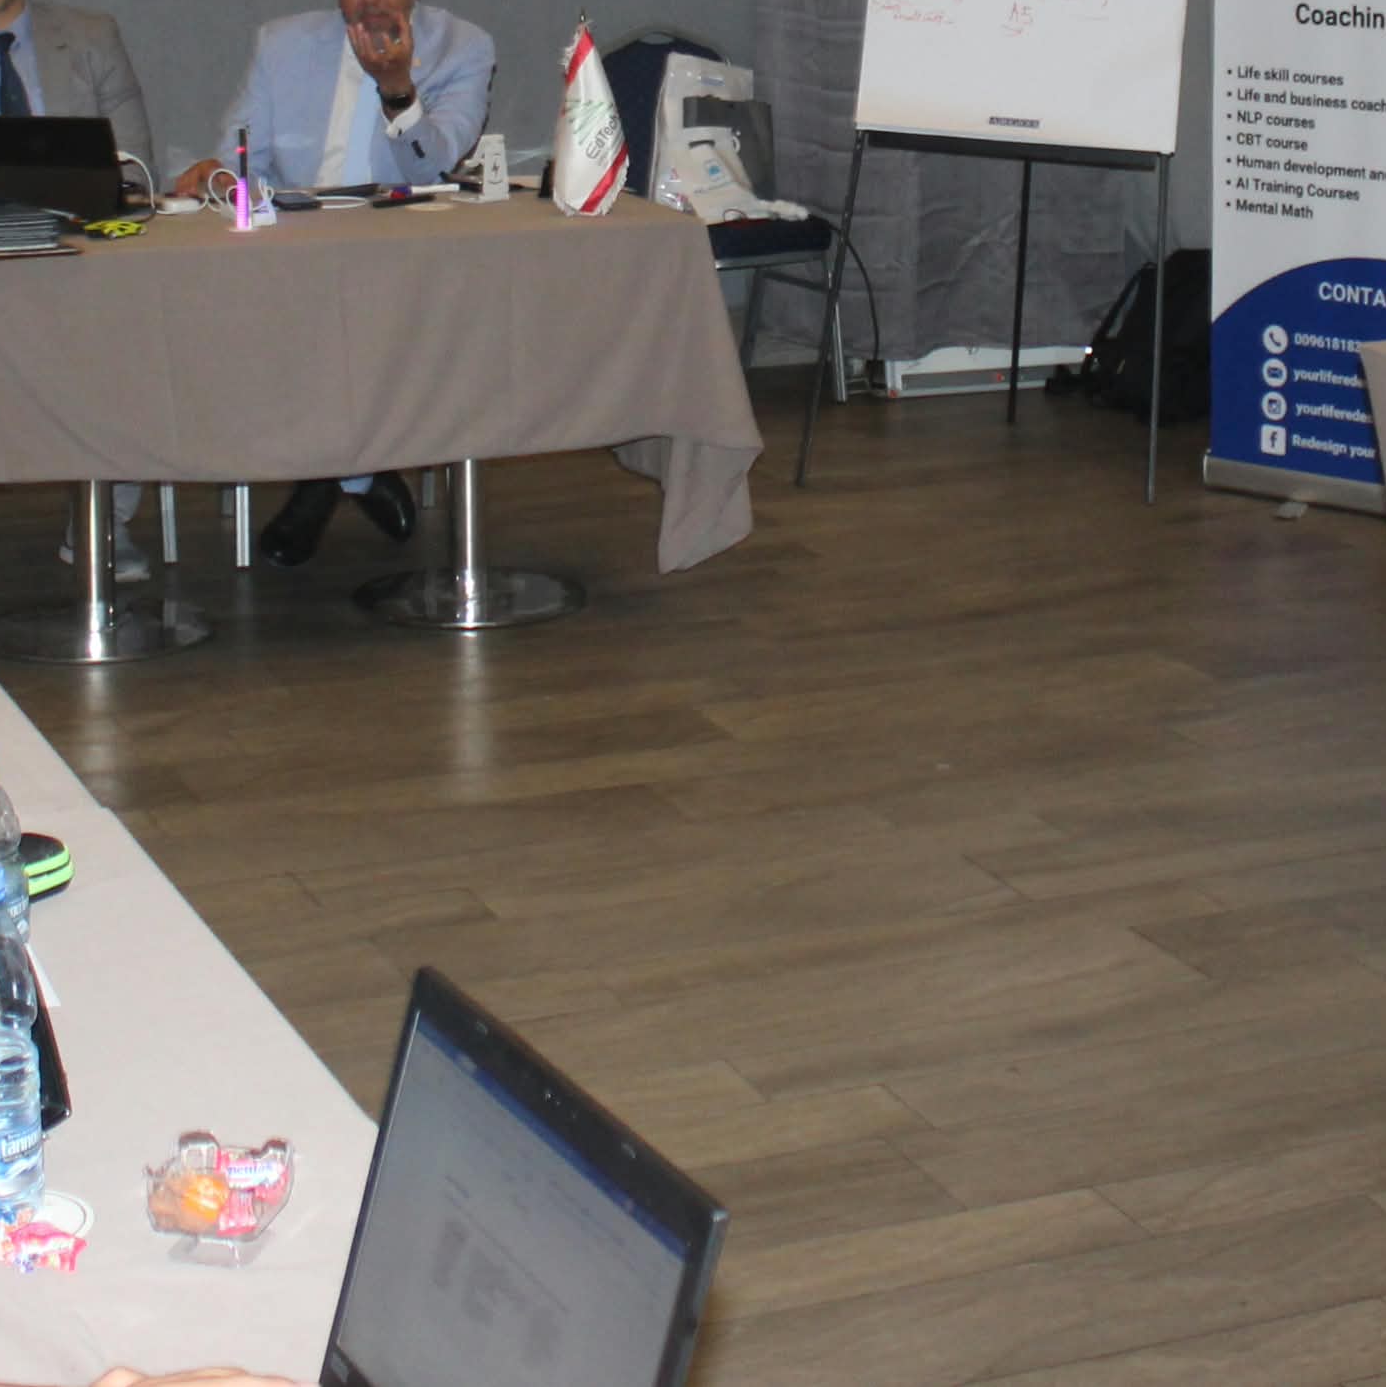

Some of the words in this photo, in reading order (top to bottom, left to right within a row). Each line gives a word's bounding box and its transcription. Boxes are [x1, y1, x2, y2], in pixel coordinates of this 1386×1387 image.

[1237, 66, 1261, 80] Life
[1264, 69, 1290, 81] skill
[1293, 72, 1344, 86] courses
[1237, 88, 1260, 102] Life
[1264, 91, 1287, 104] and
[1290, 92, 1347, 109] business
[1237, 110, 1263, 124] NLP
[1266, 114, 1315, 129] courses
[1236, 132, 1262, 146] CBT
[1266, 137, 1308, 151] course
[1236, 154, 1280, 170] Human
[1284, 159, 1366, 179] development
[1236, 177, 1249, 190] AI
[1253, 178, 1303, 198] Training
[1307, 183, 1360, 201] Courses
[1236, 199, 1278, 215] Mental
[1281, 204, 1314, 219] Math
[1292, 434, 1348, 457] Redesign
[1349, 445, 1376, 459] your
